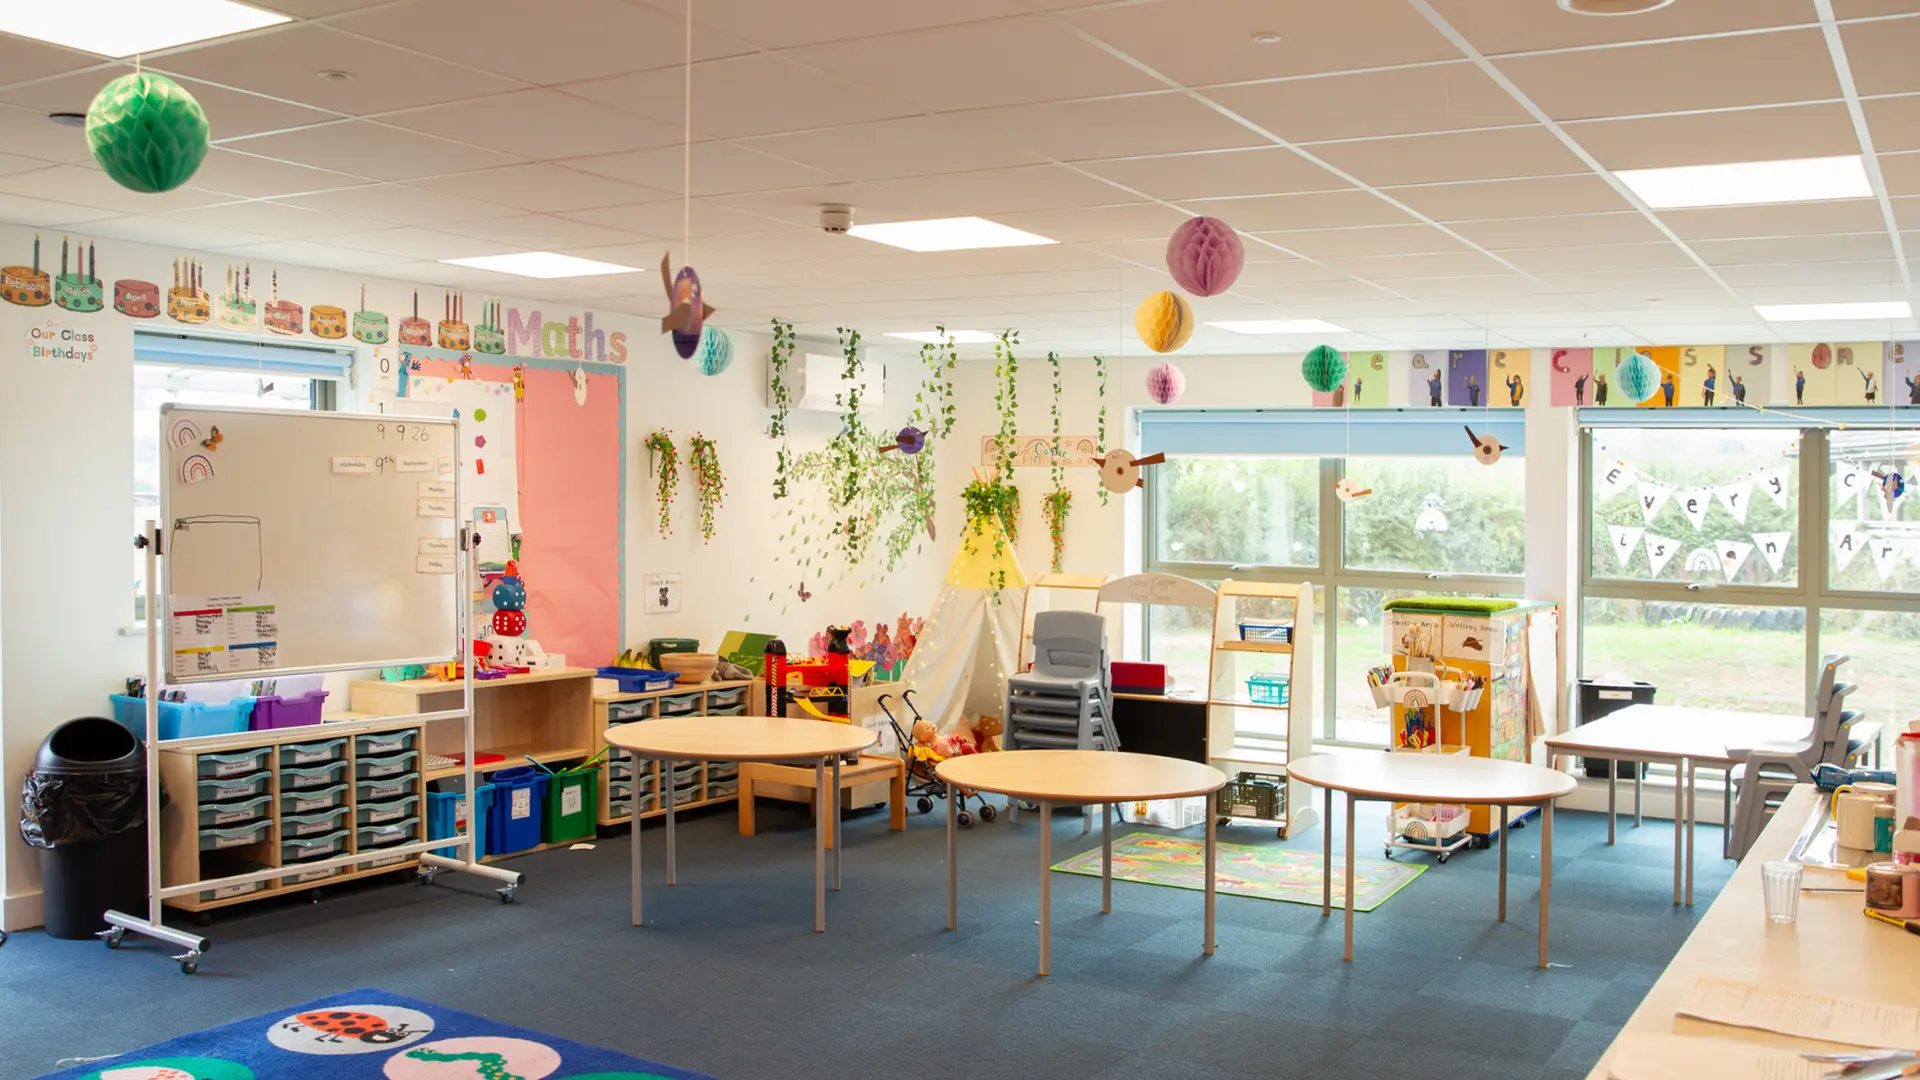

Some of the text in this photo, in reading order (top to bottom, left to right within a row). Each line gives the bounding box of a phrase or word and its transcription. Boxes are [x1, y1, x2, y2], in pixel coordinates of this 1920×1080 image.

[5, 276, 46, 291] February
[66, 286, 93, 297] March
[126, 293, 147, 303] April
[31, 327, 95, 342] Our Class
[507, 308, 628, 363] Maths
[32, 346, 94, 363] Birthdays
[380, 358, 390, 373] 0
[379, 402, 384, 414] 1
[1620, 534, 1665, 557] is
